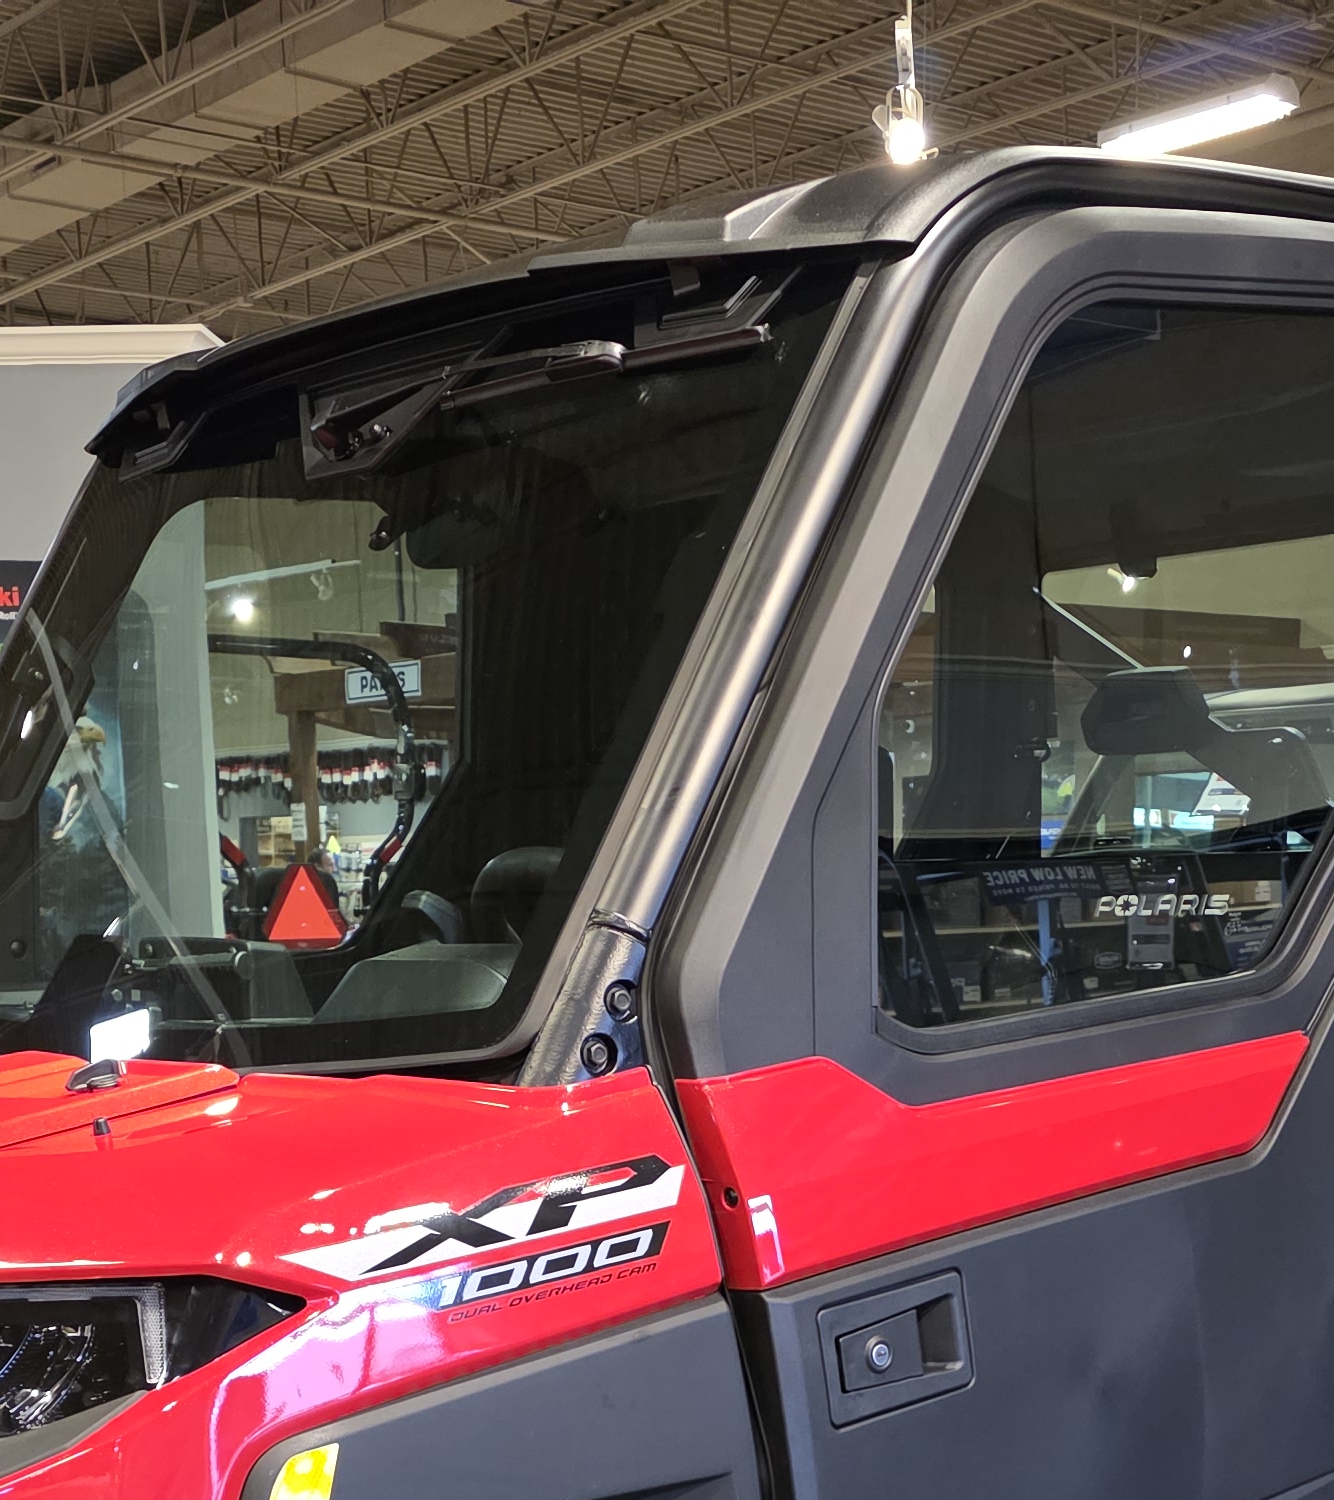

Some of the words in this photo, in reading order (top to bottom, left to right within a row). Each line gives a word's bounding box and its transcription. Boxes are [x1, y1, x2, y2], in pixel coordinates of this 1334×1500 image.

[360, 671, 406, 694] PAS
[1094, 894, 1230, 918] POLARIS
[358, 1153, 672, 1276] XP
[436, 1229, 655, 1309] 1000
[449, 1304, 503, 1322] DUAL
[508, 1274, 614, 1308] OVERHEAD
[616, 1262, 658, 1281] CAM
